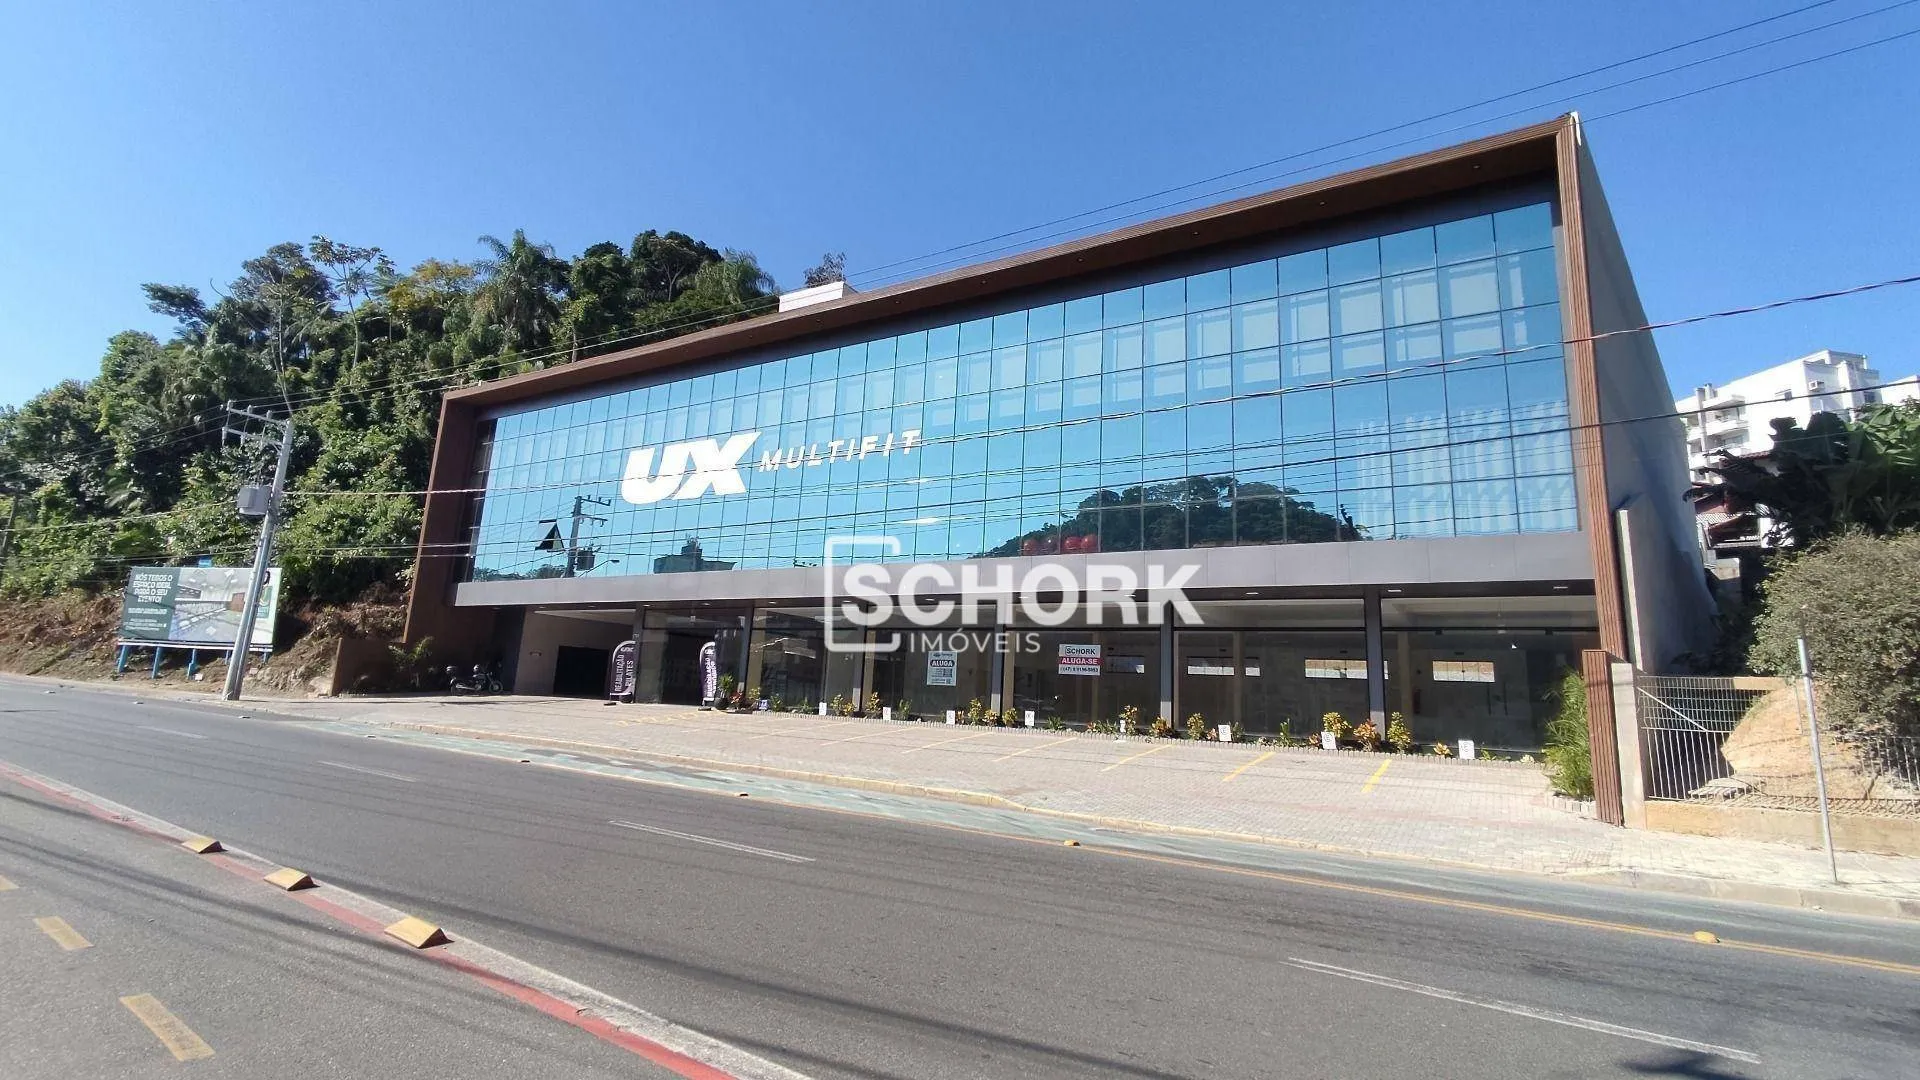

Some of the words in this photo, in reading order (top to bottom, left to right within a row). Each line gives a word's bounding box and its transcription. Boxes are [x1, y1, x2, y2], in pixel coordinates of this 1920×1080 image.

[621, 431, 762, 505] UX
[758, 429, 922, 473] MULTIFIT
[1066, 647, 1096, 655] SCHORK
[625, 660, 634, 687] PILATES
